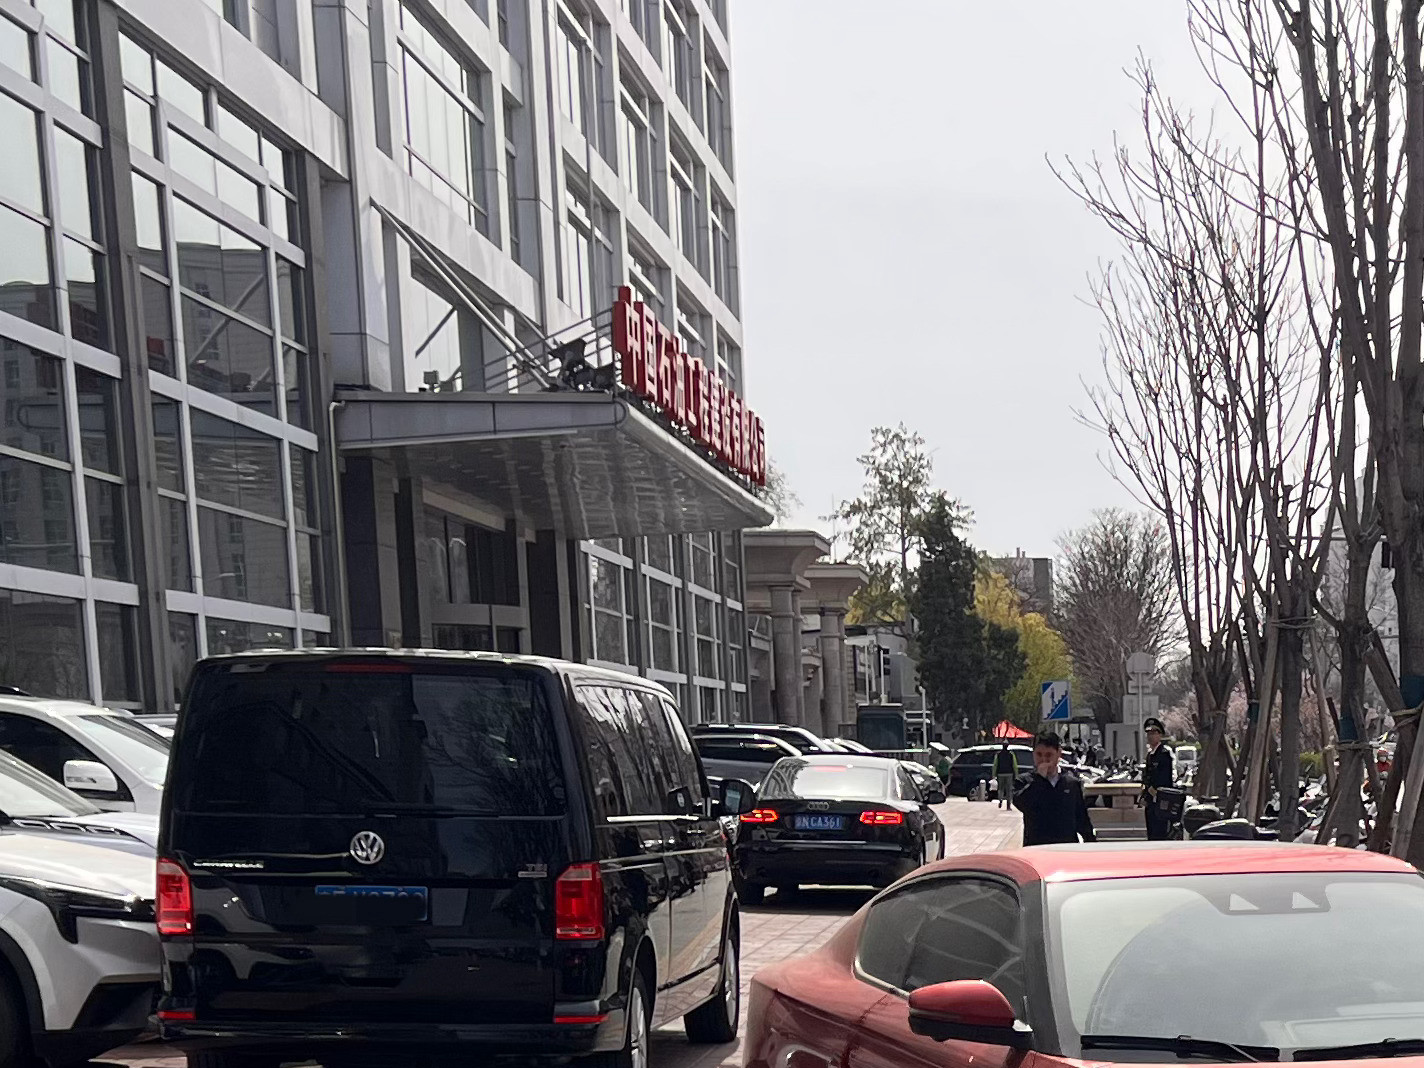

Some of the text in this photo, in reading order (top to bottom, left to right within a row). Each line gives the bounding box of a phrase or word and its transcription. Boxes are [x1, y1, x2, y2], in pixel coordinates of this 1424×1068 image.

[620, 298, 766, 486] 中国石油工程建设有限公司
